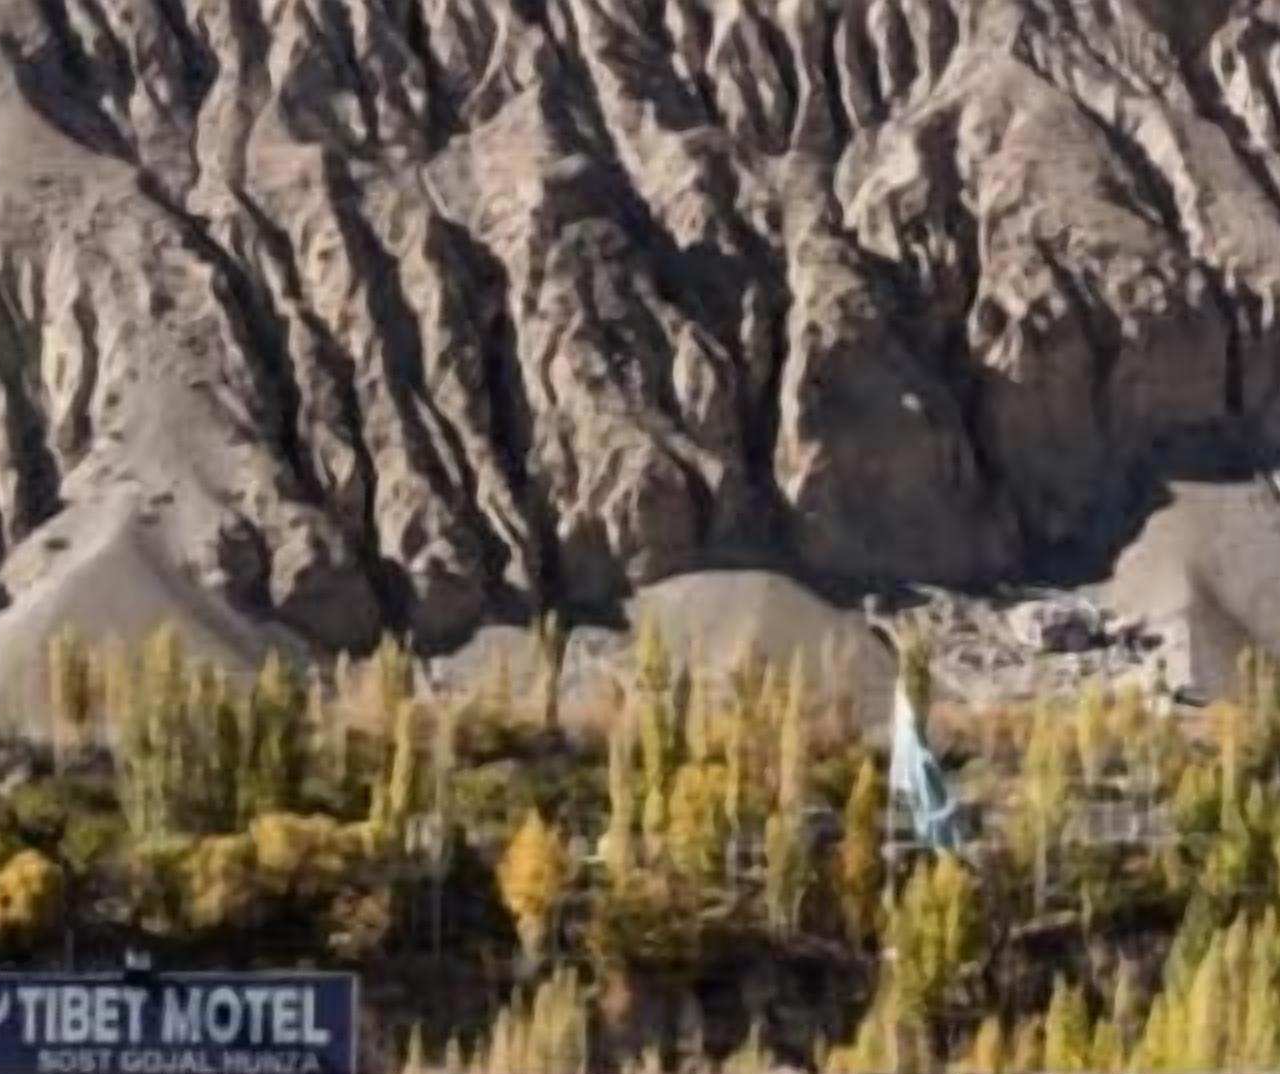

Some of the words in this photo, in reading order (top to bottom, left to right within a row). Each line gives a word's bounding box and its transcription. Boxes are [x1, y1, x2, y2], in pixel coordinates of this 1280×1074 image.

[17, 985, 148, 1045] TIBET
[160, 985, 332, 1045] MOTEL
[37, 1049, 112, 1074] SOST
[223, 1049, 320, 1074] HUNZA
